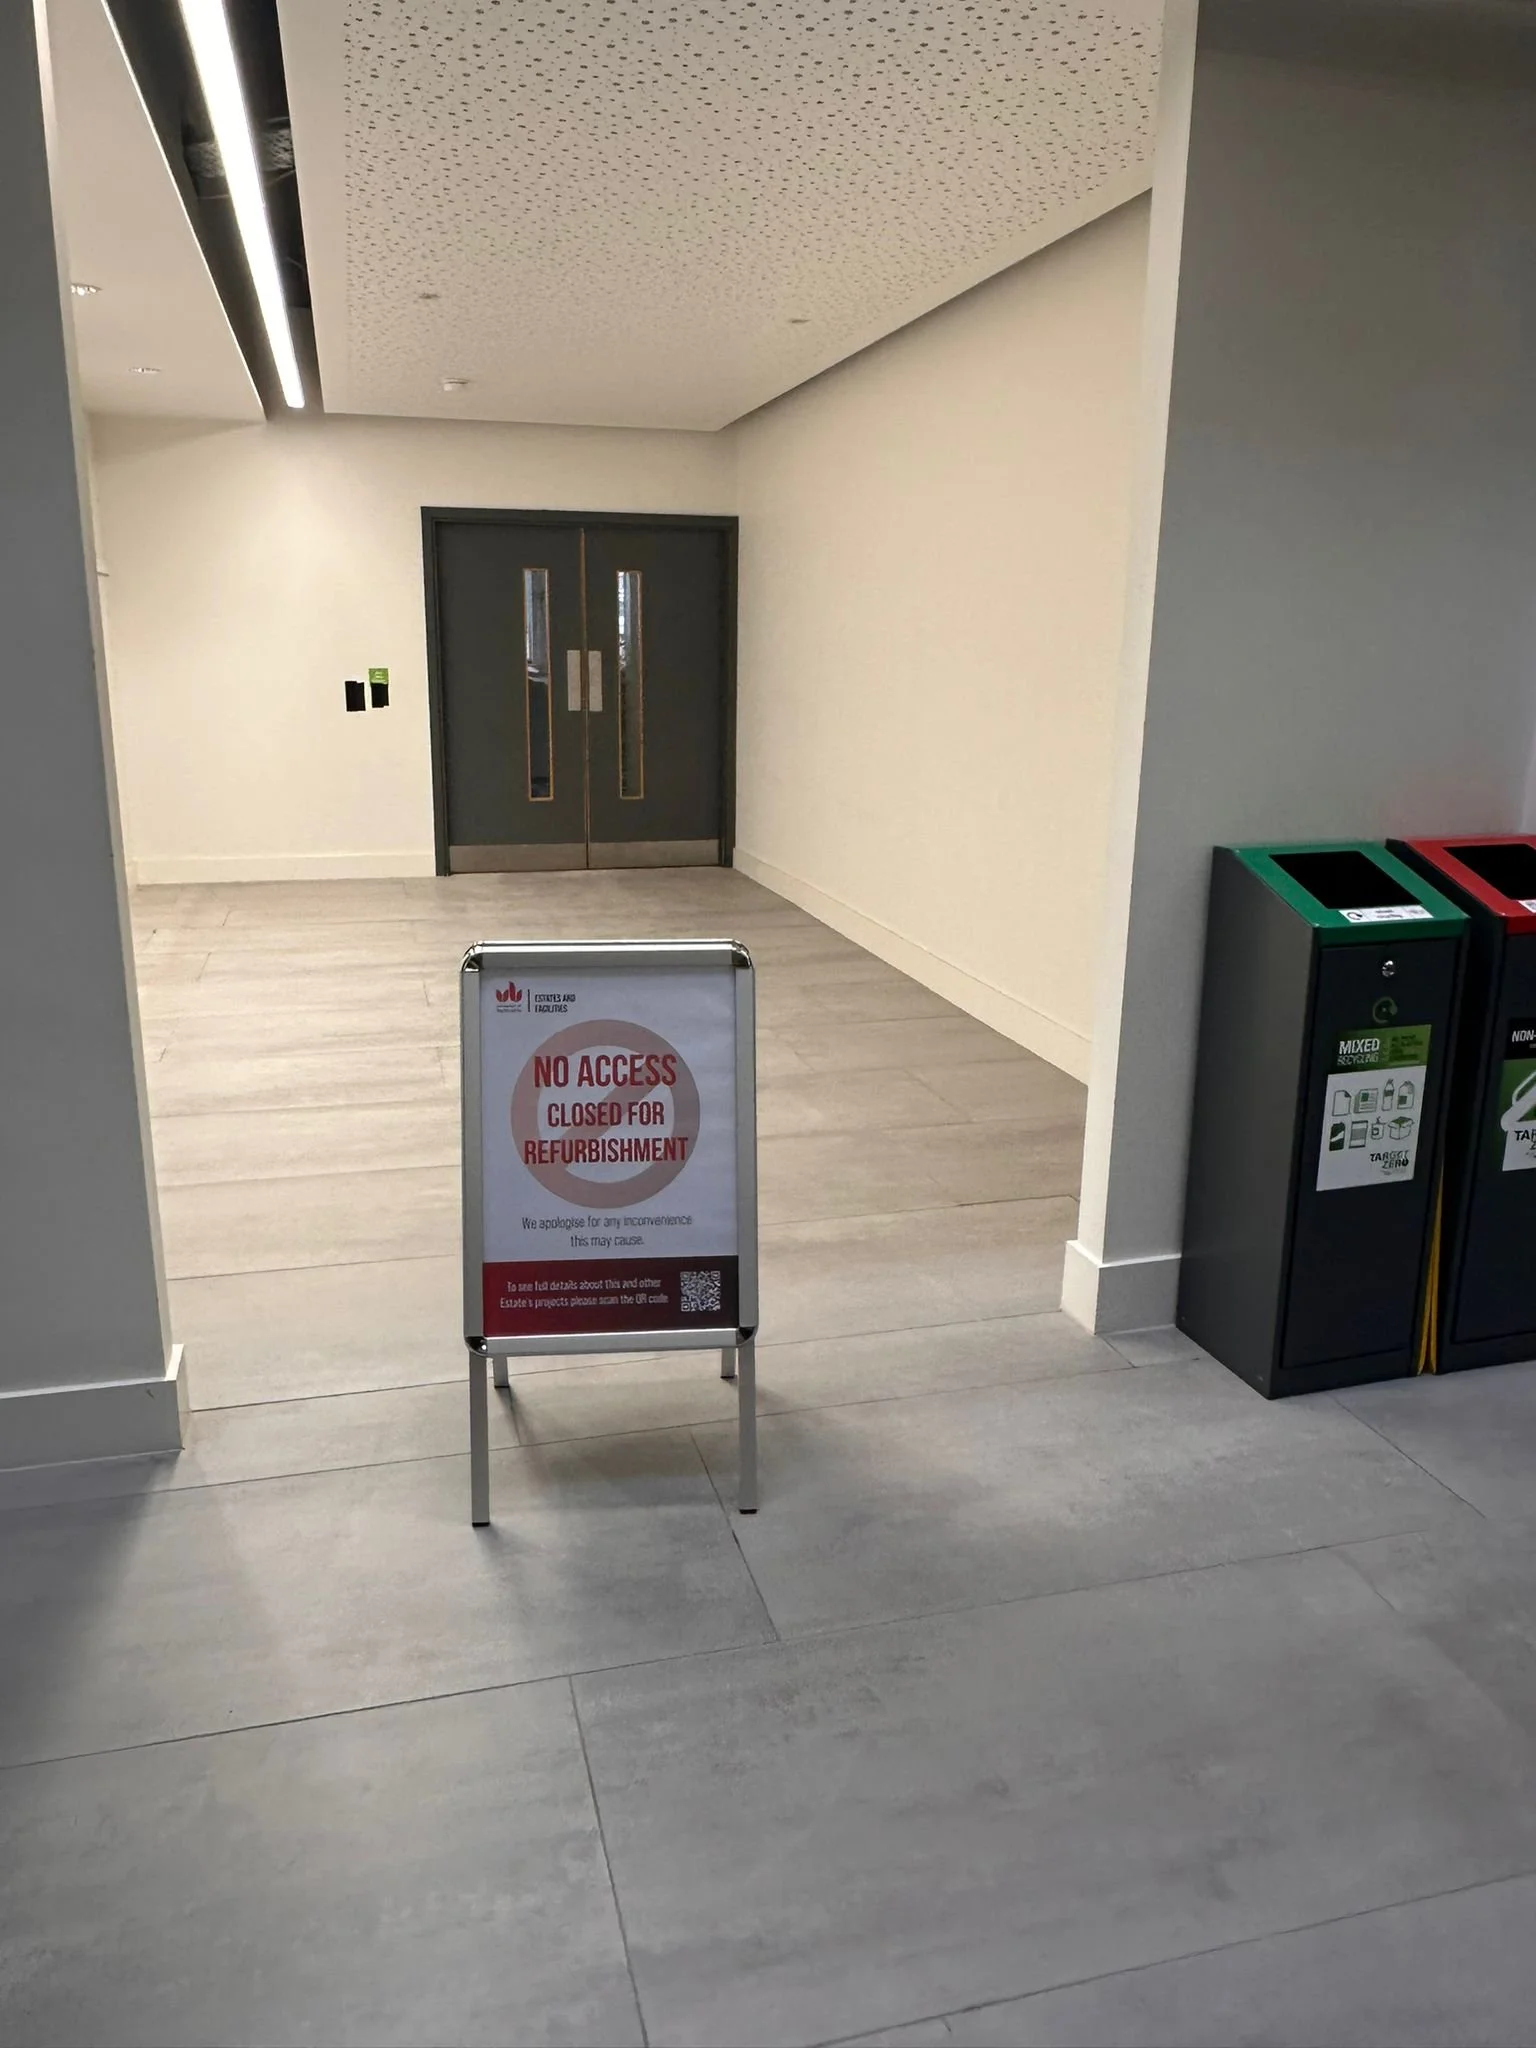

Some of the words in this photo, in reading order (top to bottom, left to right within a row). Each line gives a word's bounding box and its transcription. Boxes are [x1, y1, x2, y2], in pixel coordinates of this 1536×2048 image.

[534, 1004, 568, 1013] FACILITIES
[1338, 1038, 1380, 1055] MIXED
[1337, 1052, 1379, 1066] RECYCLING
[534, 1055, 569, 1088] NO
[577, 1054, 677, 1088] ACCESS
[547, 1102, 622, 1127] CLOSED
[628, 1101, 665, 1126] FOR
[524, 1137, 689, 1164] REFURBISHMENT
[1370, 1150, 1409, 1162] TARGET
[1381, 1158, 1410, 1170] ZERO
[522, 1217, 536, 1229] We
[539, 1216, 585, 1231] apologise
[587, 1215, 601, 1228] for
[603, 1217, 620, 1229] any
[623, 1214, 693, 1226] inconvenience
[570, 1235, 589, 1247] this
[591, 1236, 612, 1249] may
[614, 1235, 645, 1246] cause.
[507, 1281, 517, 1293] To
[518, 1282, 533, 1292] see
[534, 1280, 549, 1292] full
[550, 1279, 578, 1291] details
[579, 1279, 603, 1290] about
[622, 1277, 638, 1288] and
[639, 1277, 662, 1288] other
[534, 1296, 569, 1310] projects
[570, 1295, 598, 1308] please
[599, 1295, 619, 1305] scan
[620, 1293, 634, 1304] the
[635, 1293, 647, 1305] QR
